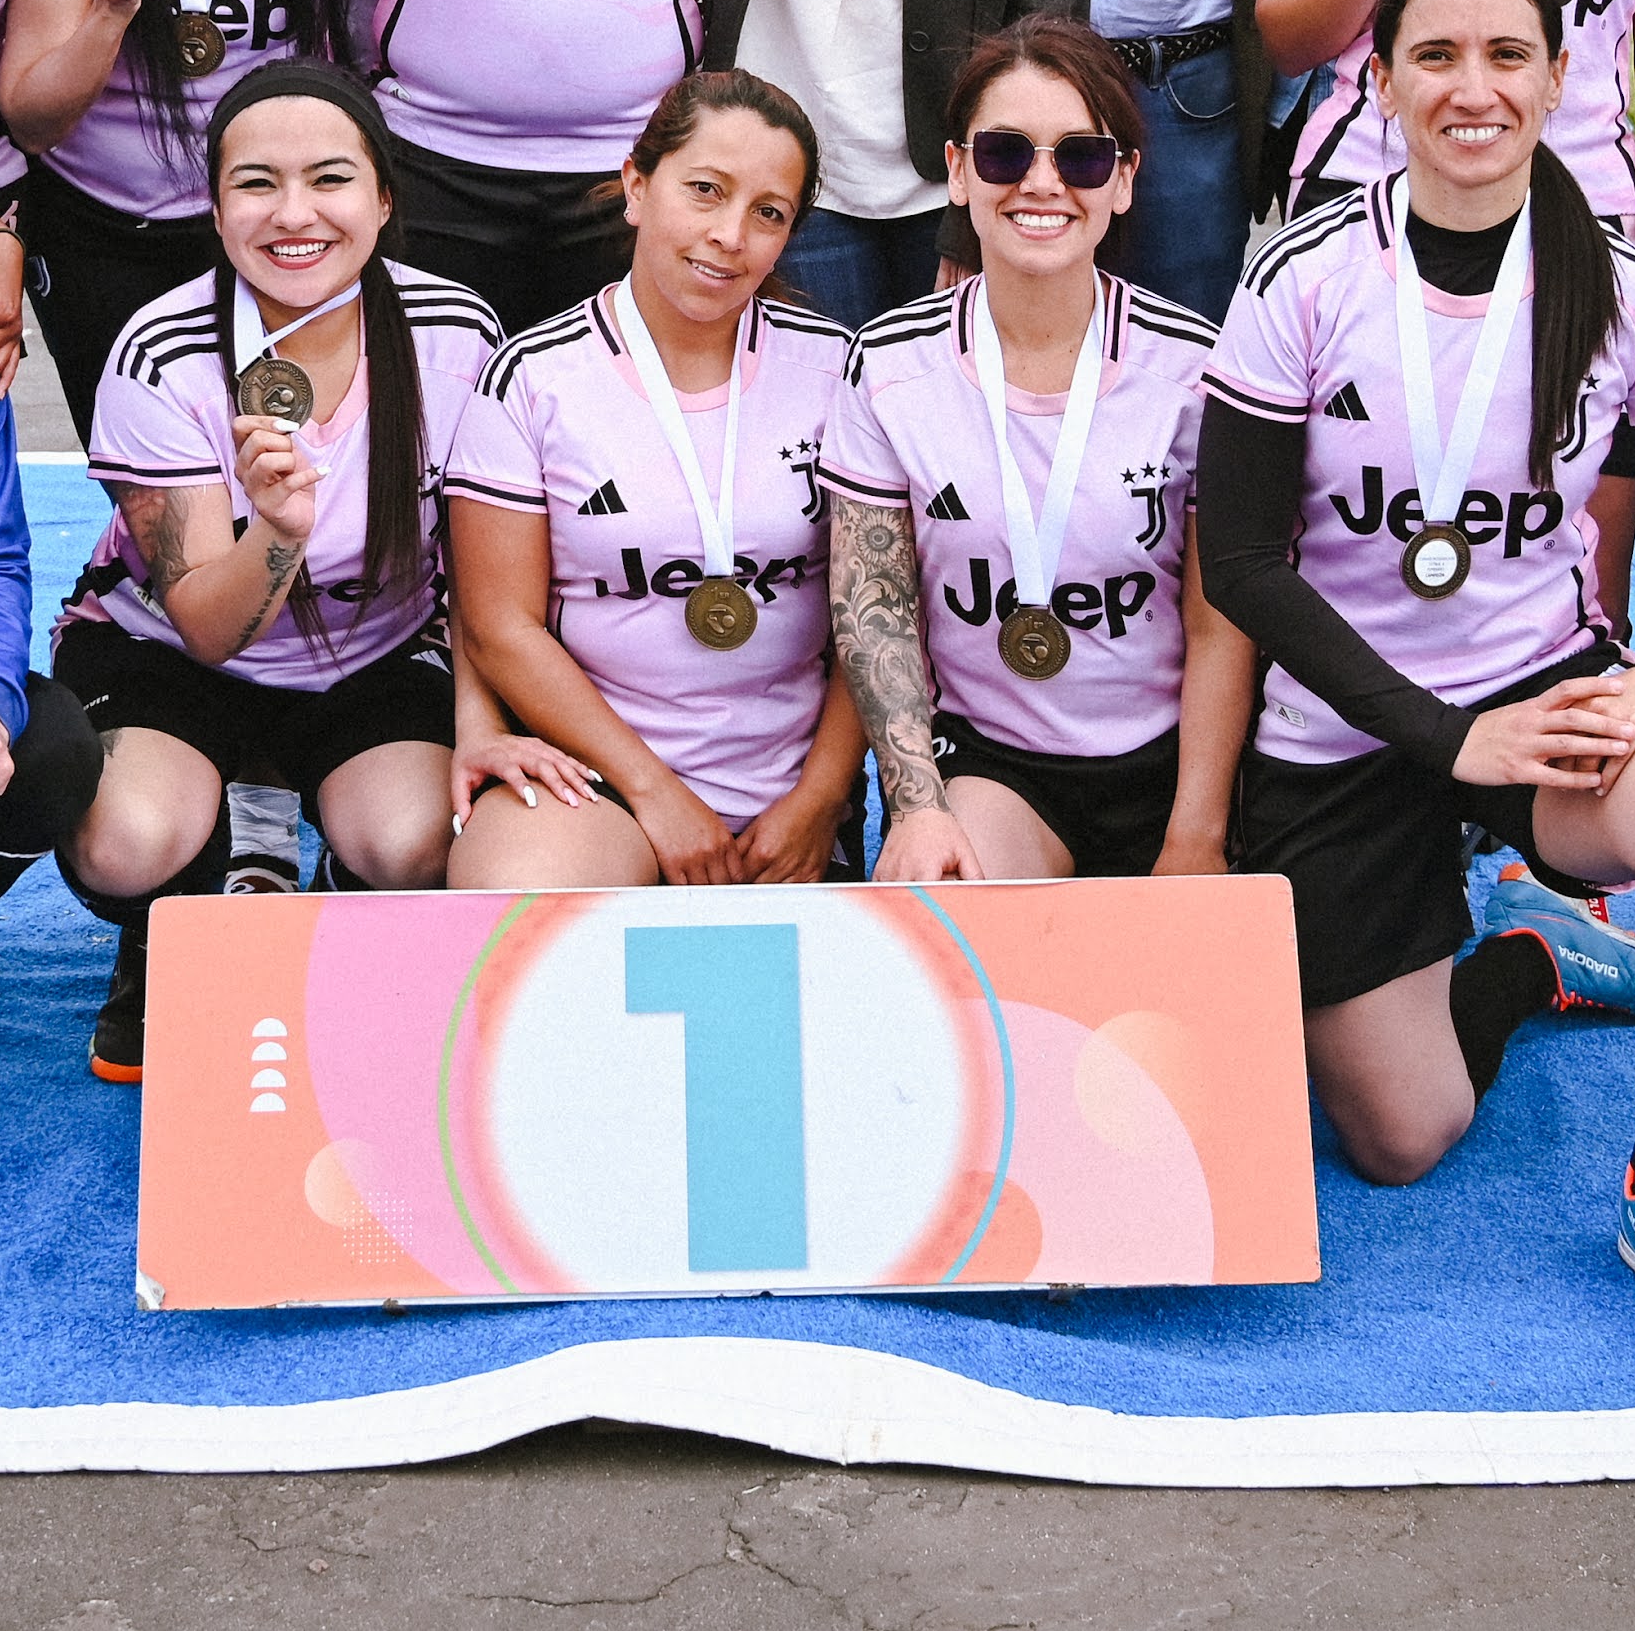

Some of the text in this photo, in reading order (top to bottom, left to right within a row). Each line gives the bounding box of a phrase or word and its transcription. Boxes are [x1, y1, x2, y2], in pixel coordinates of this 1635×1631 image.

[1327, 465, 1564, 559] Jeep
[1557, 944, 1620, 979] DIADORA
[623, 923, 809, 1273] 1
